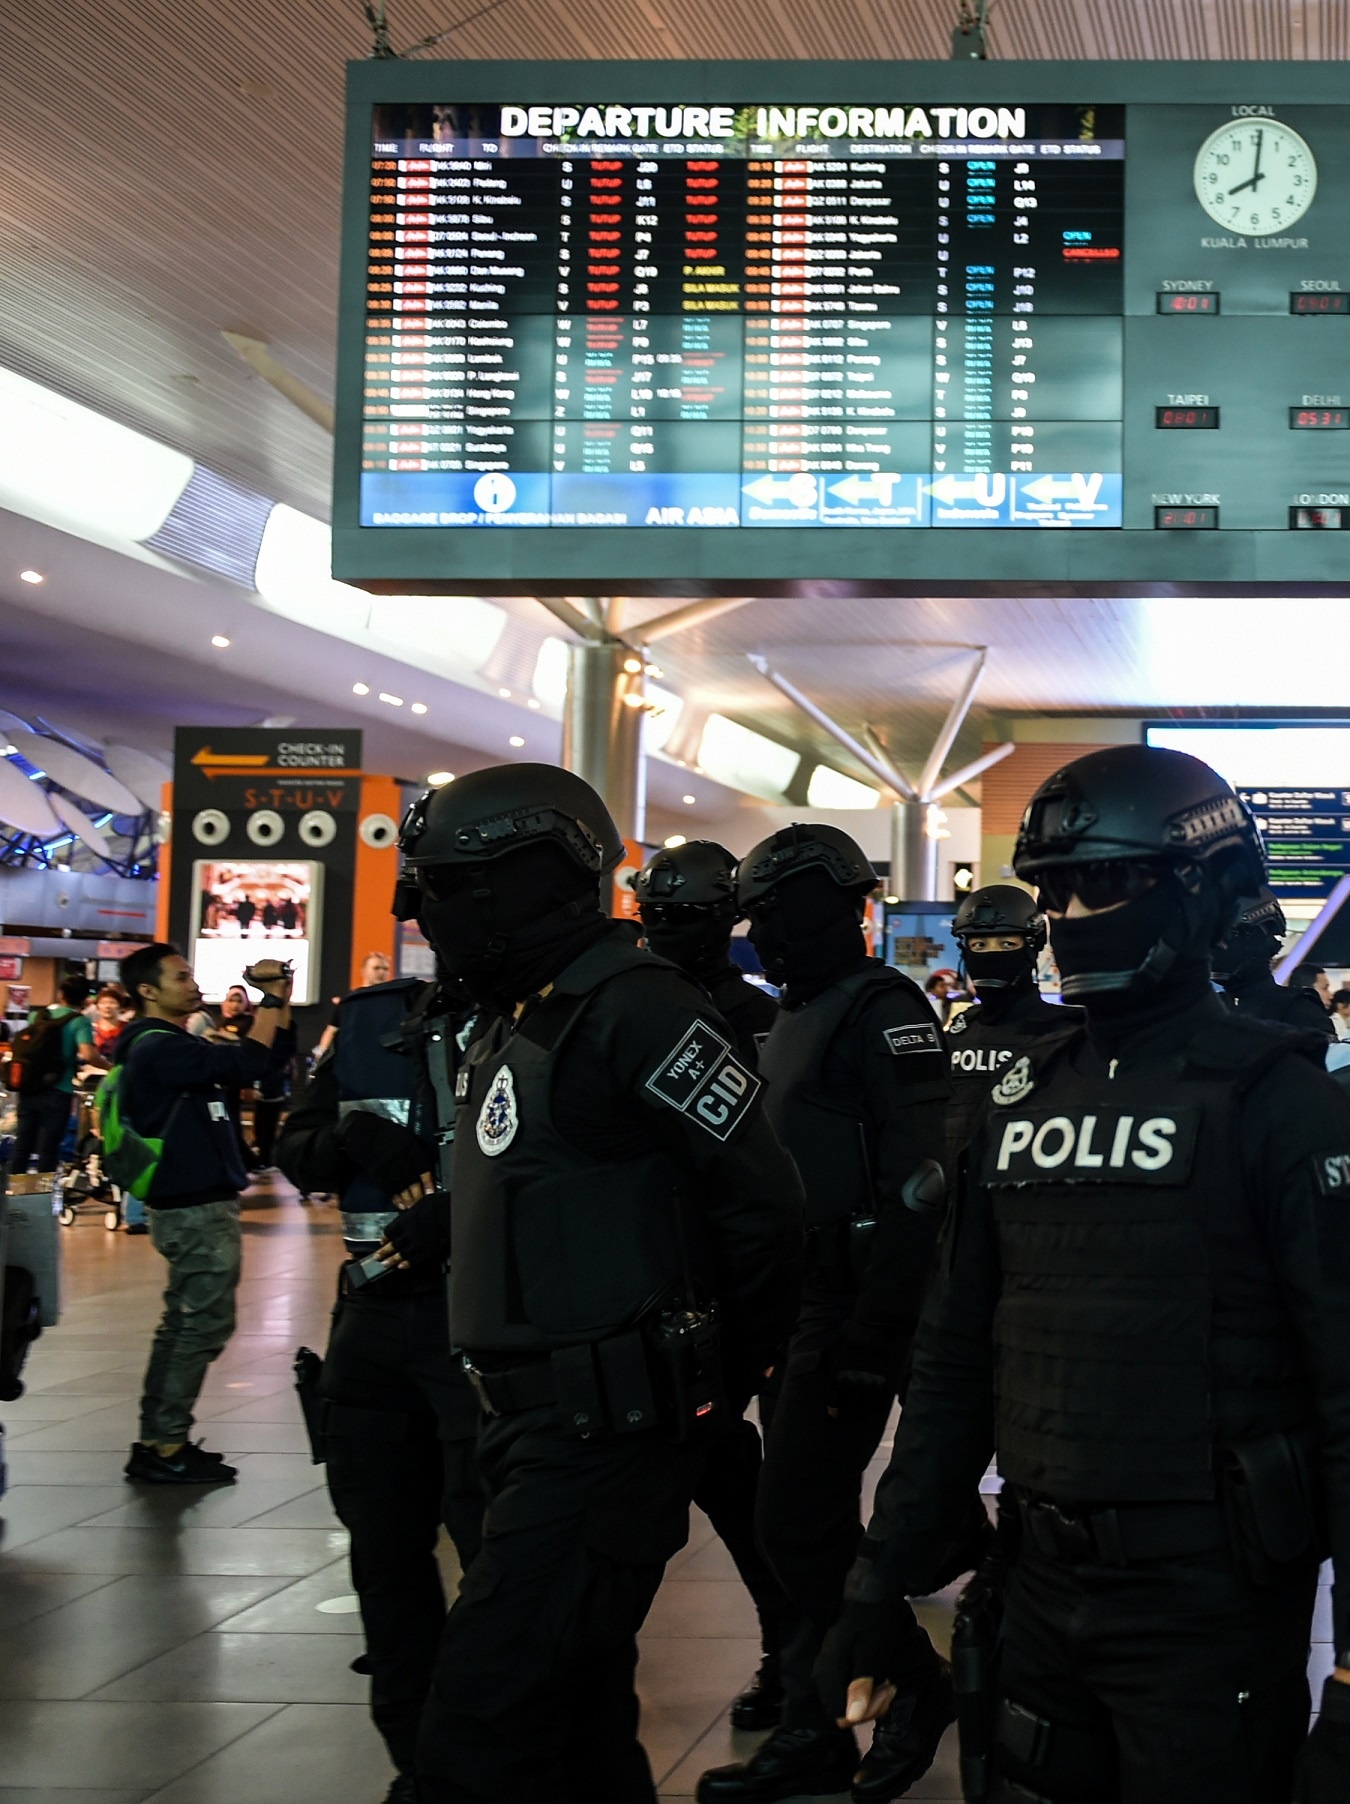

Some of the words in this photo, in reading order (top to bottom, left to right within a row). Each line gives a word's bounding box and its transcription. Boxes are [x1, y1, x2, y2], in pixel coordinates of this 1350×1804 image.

[1231, 106, 1275, 116] LOCAL
[501, 106, 735, 138] DEPARTURE
[757, 106, 1025, 138] INFORMATION
[375, 144, 398, 153] TIME
[420, 144, 454, 153] FLIGHT
[482, 144, 498, 153] TO
[591, 144, 631, 153] REMARK
[632, 144, 658, 153] GATE
[663, 144, 684, 153] ETD
[686, 144, 724, 153] STATUS
[750, 145, 773, 154] TIME
[796, 145, 829, 154] FLIGHT
[850, 145, 911, 154] DESTINATION
[968, 145, 1008, 154] REMARK
[1009, 145, 1035, 154] GATE
[1040, 145, 1061, 154] ETD
[1063, 145, 1101, 154] STATUS
[1232, 141, 1241, 151] 11
[1274, 142, 1279, 152] 1
[1216, 155, 1230, 166] 10
[1288, 156, 1297, 167] 2
[1210, 173, 1218, 184] 9
[1294, 175, 1303, 186] 3
[1216, 193, 1224, 204] 8
[1286, 194, 1295, 205] 4
[1231, 207, 1241, 218] 7
[1272, 208, 1281, 219] 5
[636, 215, 658, 225] K12
[1251, 213, 1259, 224] 6
[1013, 233, 1029, 244] L2
[1201, 237, 1247, 248] KUALA
[1254, 237, 1309, 249] LUMPUR
[1162, 281, 1214, 291] SYDNEY
[1301, 281, 1341, 291] SEOUL
[1168, 395, 1209, 406] TAIPEI
[1302, 395, 1340, 406] DELHI
[1298, 412, 1340, 424] 0531
[870, 473, 901, 506] T
[974, 473, 1005, 507] U
[1152, 494, 1182, 504] NEW
[1185, 494, 1220, 504] YORK
[1293, 494, 1349, 504] LONDON
[645, 507, 684, 525] AIR
[686, 507, 740, 525] ASIA
[277, 743, 345, 754] CHECK-IN
[277, 755, 345, 767] COUNTER
[893, 1034, 924, 1046] DELTA
[666, 1040, 703, 1079] YONEX
[951, 1050, 1013, 1071] POLIS
[688, 1060, 705, 1080] A+
[697, 1065, 747, 1125] CID
[997, 1115, 1177, 1171] POLIS
